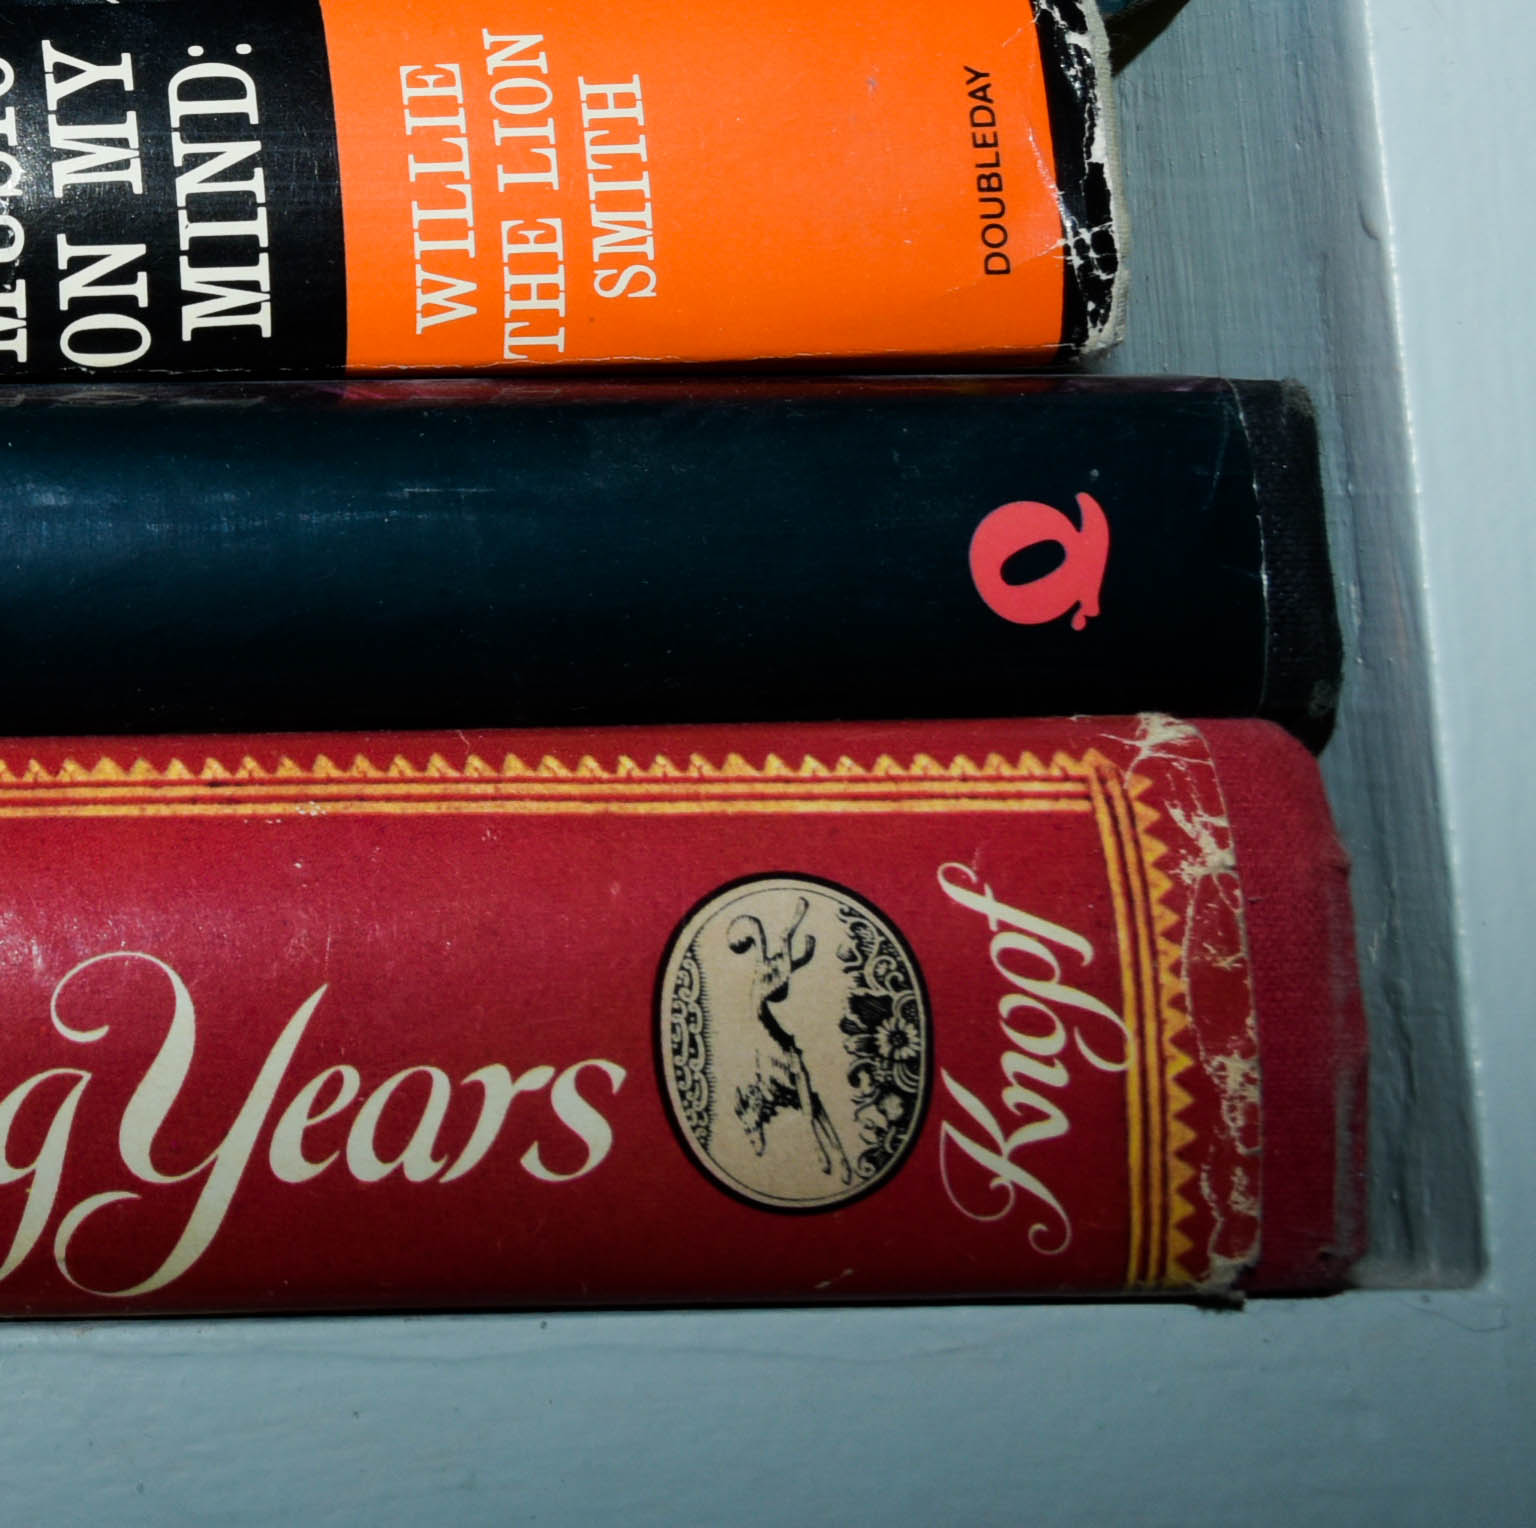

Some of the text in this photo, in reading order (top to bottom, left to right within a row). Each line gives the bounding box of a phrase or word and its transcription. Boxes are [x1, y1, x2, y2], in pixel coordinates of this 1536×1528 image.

[41, 39, 152, 368] ON MY
[167, 43, 271, 342] MIND:
[399, 63, 477, 335] WILLIE
[482, 28, 565, 359] THE LION
[578, 74, 657, 298] SMITH
[963, 65, 1011, 275] DOUBLEDAY
[50, 950, 627, 1297] Years
[937, 861, 1133, 1255] Knopf
